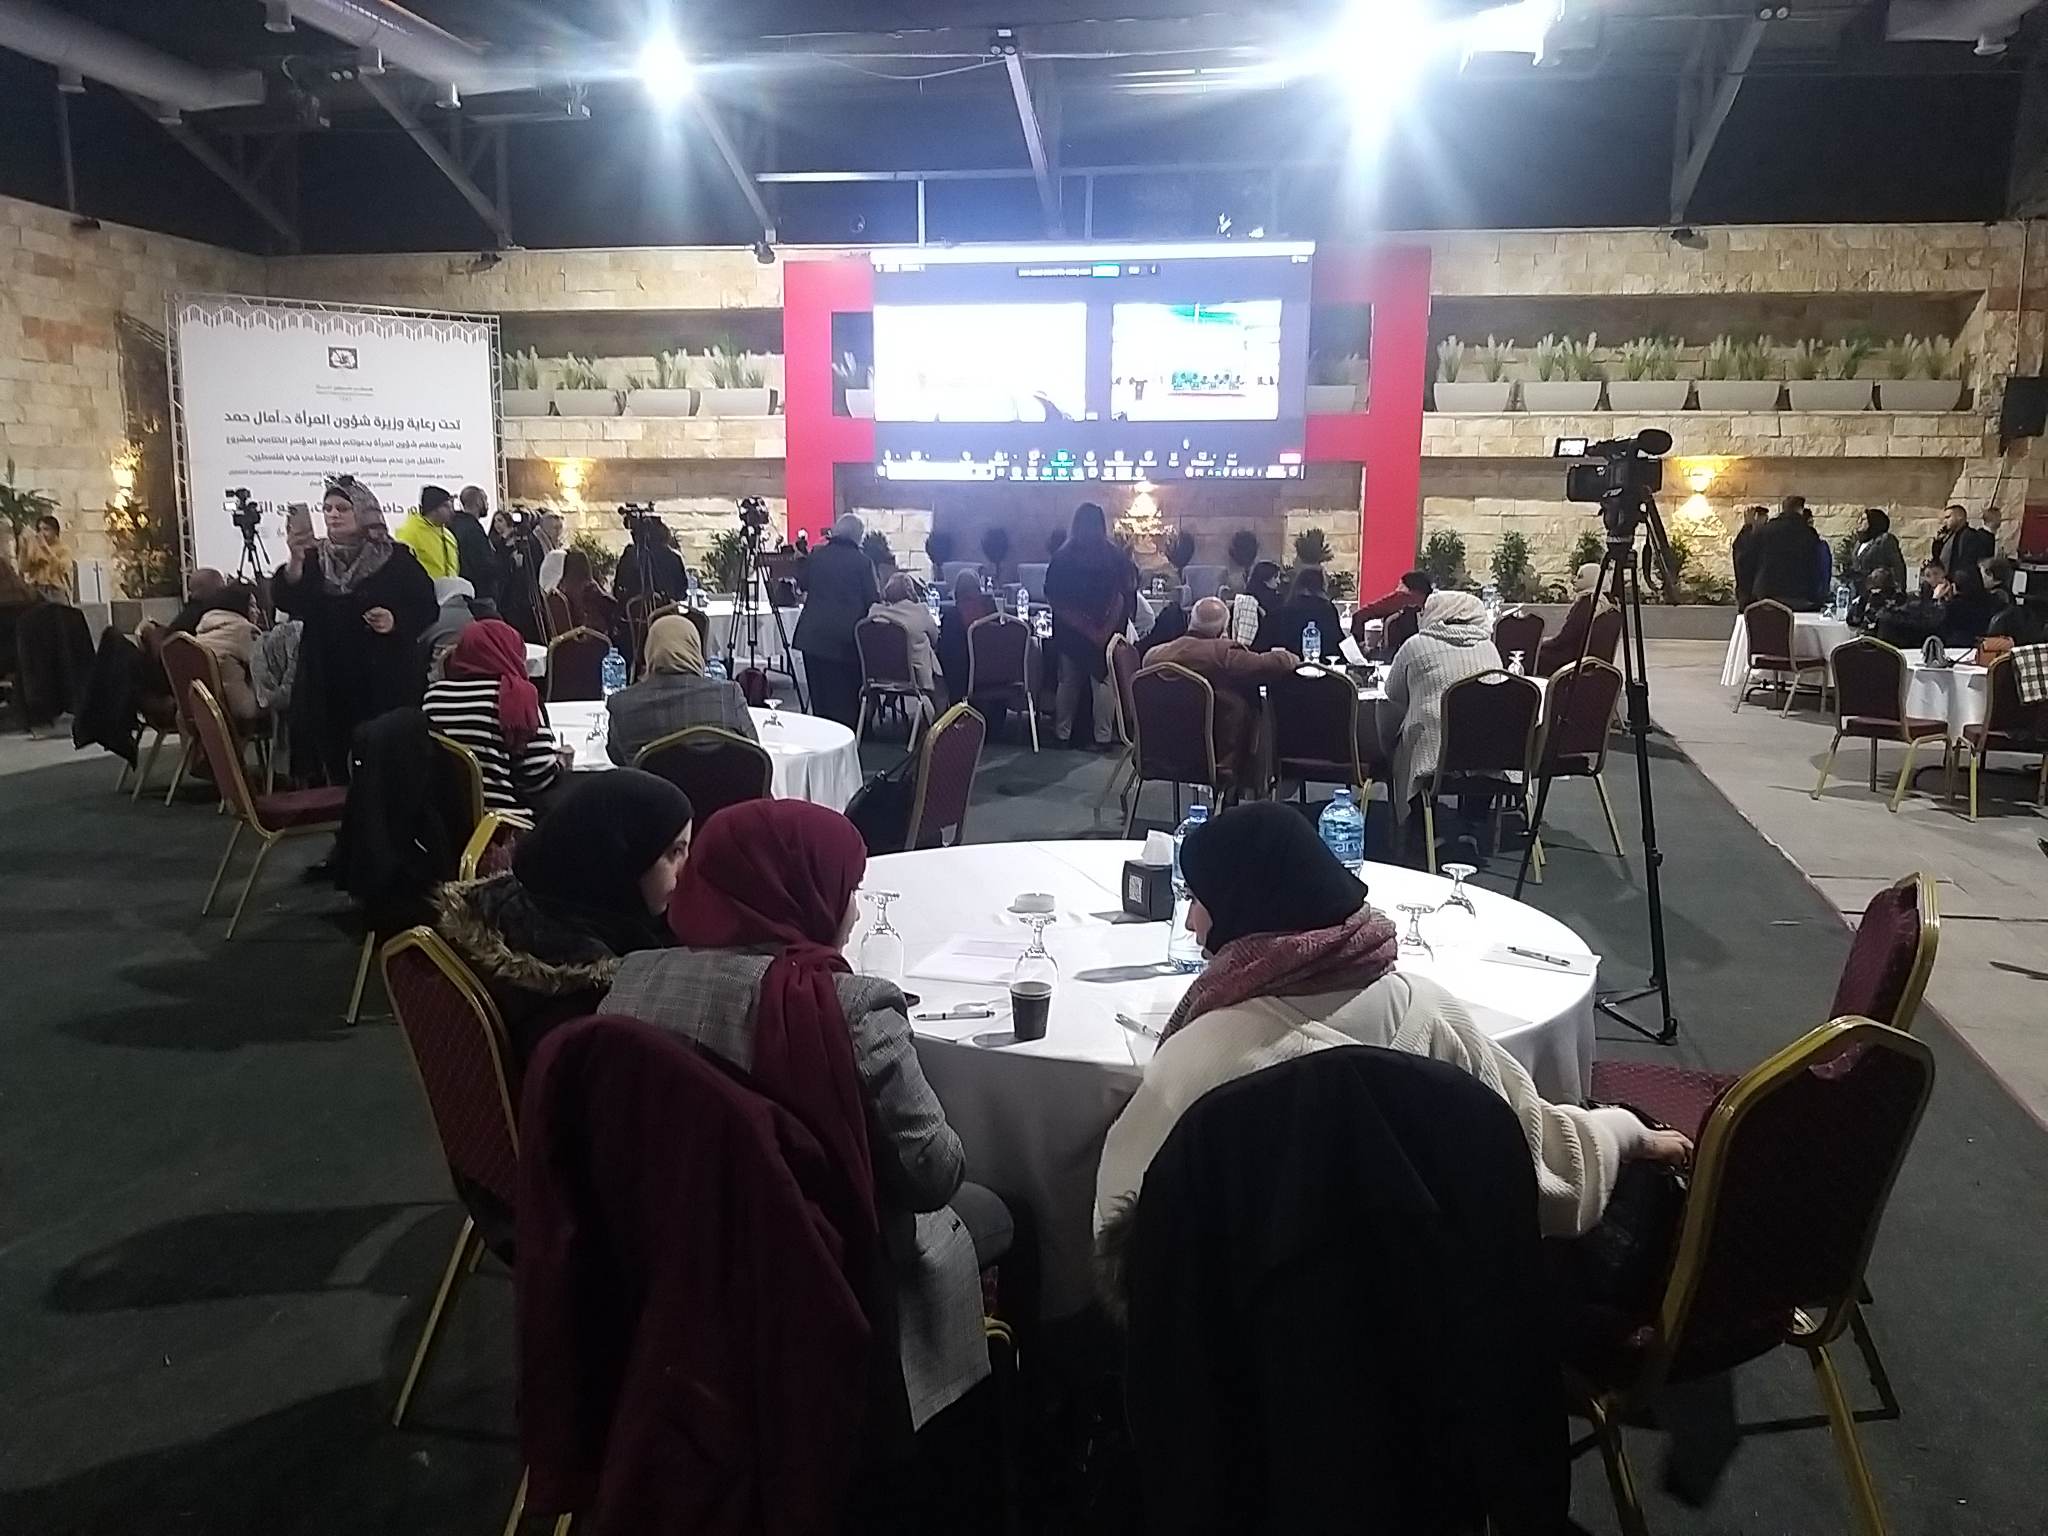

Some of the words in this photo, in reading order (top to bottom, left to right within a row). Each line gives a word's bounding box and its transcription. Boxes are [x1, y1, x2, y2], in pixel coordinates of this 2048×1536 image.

[224, 411, 251, 423] حمد
[295, 409, 331, 427] المرأة
[334, 413, 371, 429] شؤون
[374, 415, 405, 431] وزيرة
[407, 416, 436, 432] رعاية
[439, 417, 461, 430] تحت
